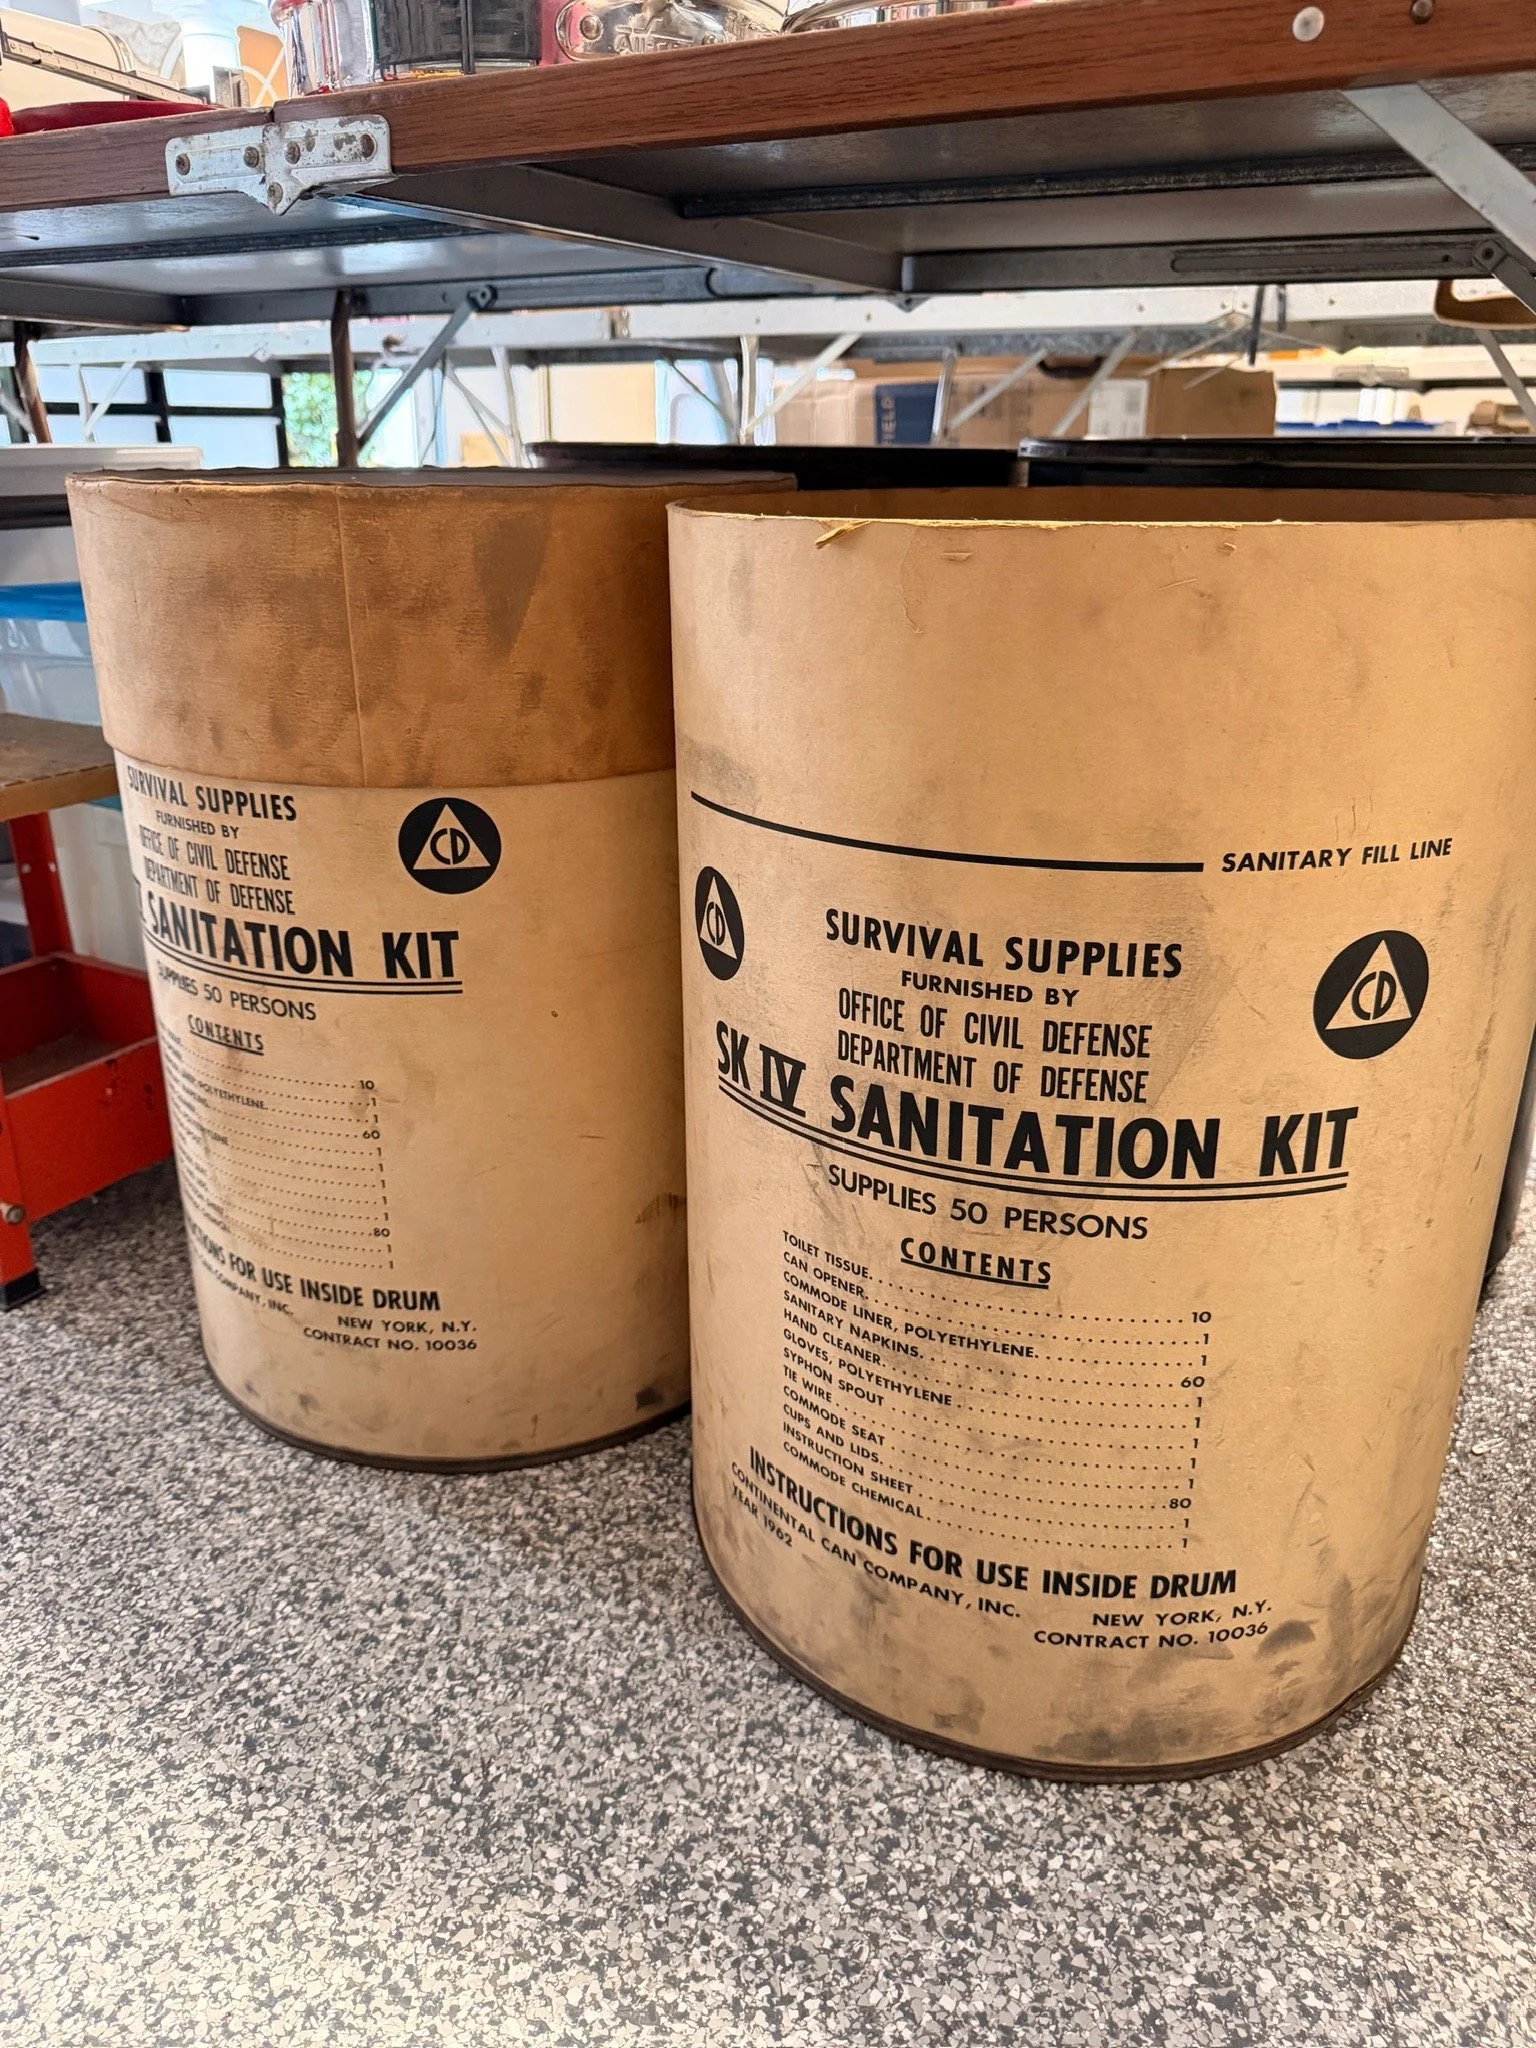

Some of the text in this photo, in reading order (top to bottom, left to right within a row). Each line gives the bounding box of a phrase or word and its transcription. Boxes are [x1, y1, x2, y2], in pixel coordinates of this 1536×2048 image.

[127, 765, 298, 822] SURVIVAL SUPPLIES
[156, 809, 240, 839] FURNISHED BY
[429, 827, 471, 866] CD
[168, 836, 180, 861] OF
[186, 841, 218, 871] CIVIL
[225, 848, 291, 881] DEFENSE
[1221, 837, 1454, 874] SANITARY FILL LINE
[144, 856, 199, 899] DEPARTMENT
[206, 879, 221, 903] OF
[231, 883, 296, 916] DEFENSE
[148, 890, 354, 977] SANITATION
[381, 930, 460, 980] KIT
[825, 908, 1184, 979] SURVIVAL SUPPLIES
[203, 982, 222, 1003] 50
[230, 990, 317, 1021] PERSONS
[901, 970, 1080, 1008] FURNISHED BY
[1351, 970, 1397, 1021] CD
[188, 1013, 264, 1052] CONTENTS
[838, 987, 1153, 1059] OFFICE OF CIVIL DEFENSE
[359, 1080, 375, 1091] 10
[837, 1028, 1150, 1104] DEPARTMENT OF DEFENSE
[715, 1020, 1360, 1181] SK IV SANITATION KIT
[362, 1129, 381, 1141] 60
[828, 1163, 1149, 1241] SUPPLIES 50 PERSONS
[373, 1227, 391, 1238] 80
[900, 1236, 1052, 1284] CONTENTS
[228, 1252, 257, 1282] FOR
[262, 1267, 294, 1294] USE
[299, 1277, 365, 1307] INSIDE
[372, 1289, 442, 1312] DRUM
[782, 1230, 820, 1259] TOILET
[1191, 1310, 1212, 1324] 10
[783, 1251, 808, 1274] CAN
[1202, 1332, 1209, 1346] 1
[303, 1327, 478, 1352] CONTRACT NO. 10036
[337, 1315, 478, 1334] NEW YORK, N.Y.
[783, 1271, 848, 1312] COMMODE
[853, 1304, 898, 1333] LINER,
[1200, 1354, 1208, 1367] 1
[784, 1289, 844, 1329] SANITARY
[1180, 1376, 1206, 1389] 60
[783, 1347, 833, 1385] SYPHON
[838, 1378, 885, 1407] SPOUT
[783, 1328, 1201, 1429] GLOVES, POLYETHYLENE 1
[783, 1364, 798, 1384] TIE
[802, 1376, 833, 1403] WIRE
[784, 1308, 818, 1337] HAND
[1196, 1396, 1203, 1408] 1
[783, 1385, 847, 1431] COMMODE
[851, 1425, 886, 1447] SEAT
[783, 1403, 811, 1430] CUPS
[816, 1425, 845, 1448] AND
[1168, 1497, 1193, 1510] 80
[783, 1423, 865, 1477] INSTRUCTION
[870, 1471, 914, 1495] SHEET
[783, 1441, 847, 1488] COMMODE
[851, 1481, 925, 1519] CHEMICAL
[731, 1482, 793, 1549] YEAR 1962
[731, 1461, 1022, 1618] CONTINENTAL CAN COMPANY, INC.
[750, 1445, 1237, 1600] INSTRUCTIONS FOR USE INSIDE DRUM
[1033, 1621, 1270, 1649] CONTRACT NO. 10036
[1092, 1599, 1273, 1627] NEW YORK, N.Y.
